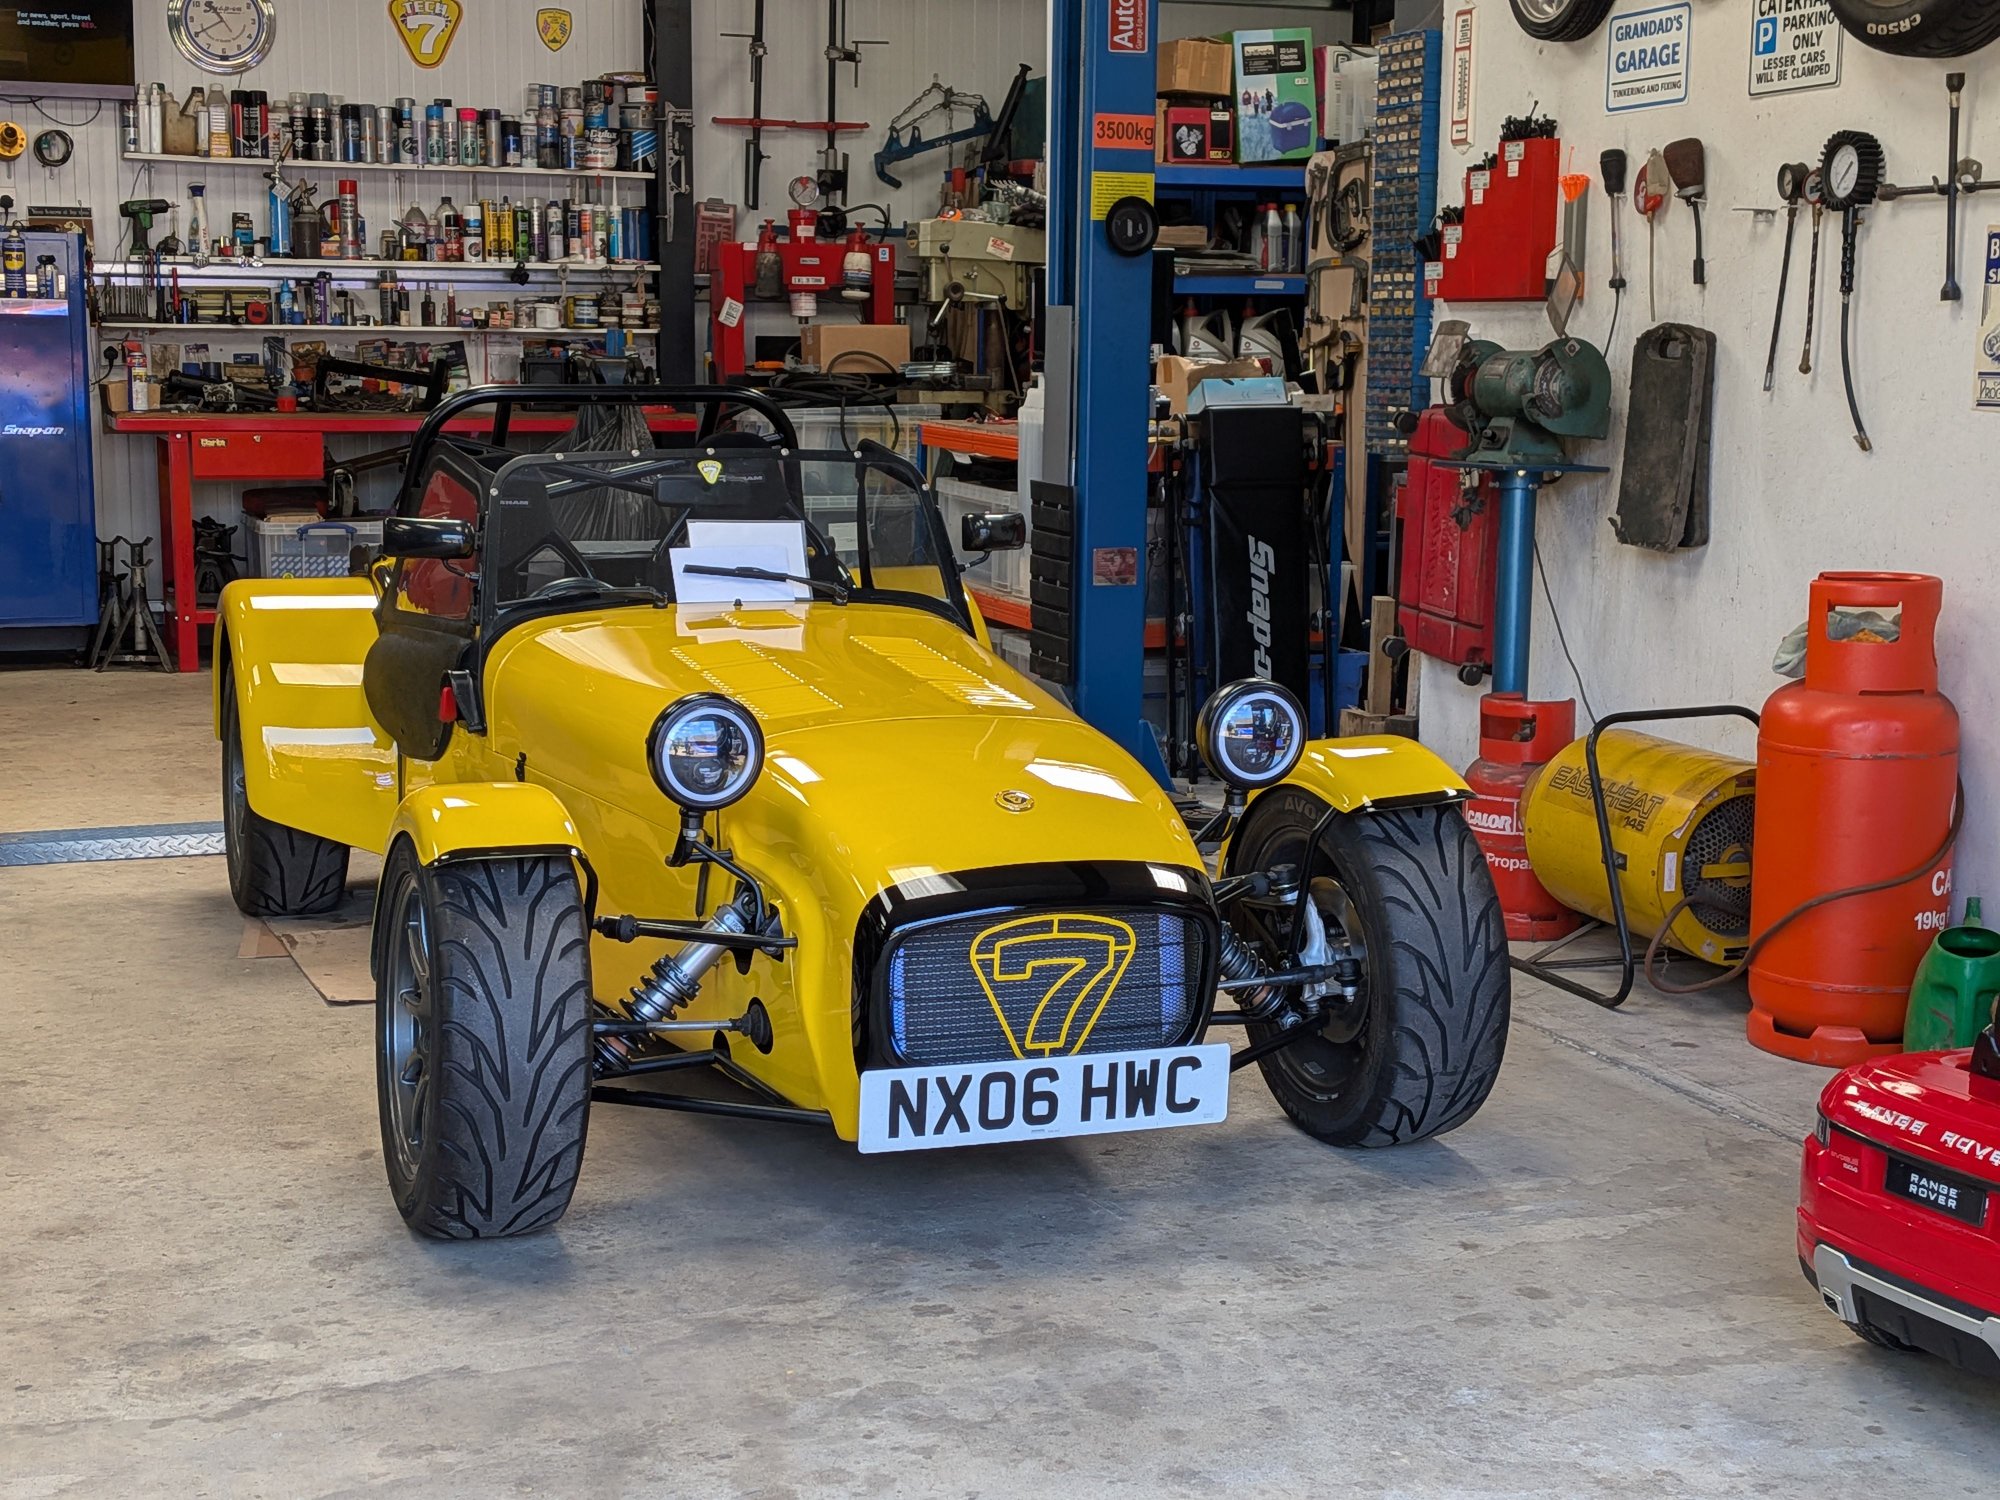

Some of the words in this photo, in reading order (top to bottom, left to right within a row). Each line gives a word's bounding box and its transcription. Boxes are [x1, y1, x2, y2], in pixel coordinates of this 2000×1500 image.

[403, 1, 448, 16] TECH
[1783, 9, 1836, 32] PARKING
[407, 15, 446, 54] 7
[1615, 15, 1683, 42] GRANDAD'S
[1866, 13, 1922, 35] CR500
[1759, 23, 1773, 52] P
[1792, 30, 1823, 51] ONLY
[1615, 42, 1681, 73] GARAGE
[1762, 54, 1796, 71] LESSER
[1800, 50, 1826, 66] CARS
[1756, 70, 1775, 85] WILL
[1777, 69, 1788, 81] BE
[1791, 63, 1831, 80] CLAMPED
[1613, 85, 1645, 98] TINKERING
[1646, 83, 1659, 93] AND
[1660, 80, 1682, 91] FIXING
[1096, 120, 1155, 146] 3500kg
[2, 424, 65, 437] Snap-on
[1284, 795, 1321, 822] AVO
[1468, 809, 1512, 833] CALOR
[1624, 815, 1647, 832] 145
[1486, 852, 1533, 871] Propa
[887, 1066, 1060, 1139] NX06
[1079, 1055, 1203, 1122] HWC
[1854, 1100, 1929, 1136] RANGE
[1908, 1183, 1957, 1209] ROVER
[1910, 1173, 1959, 1198] RANGE
